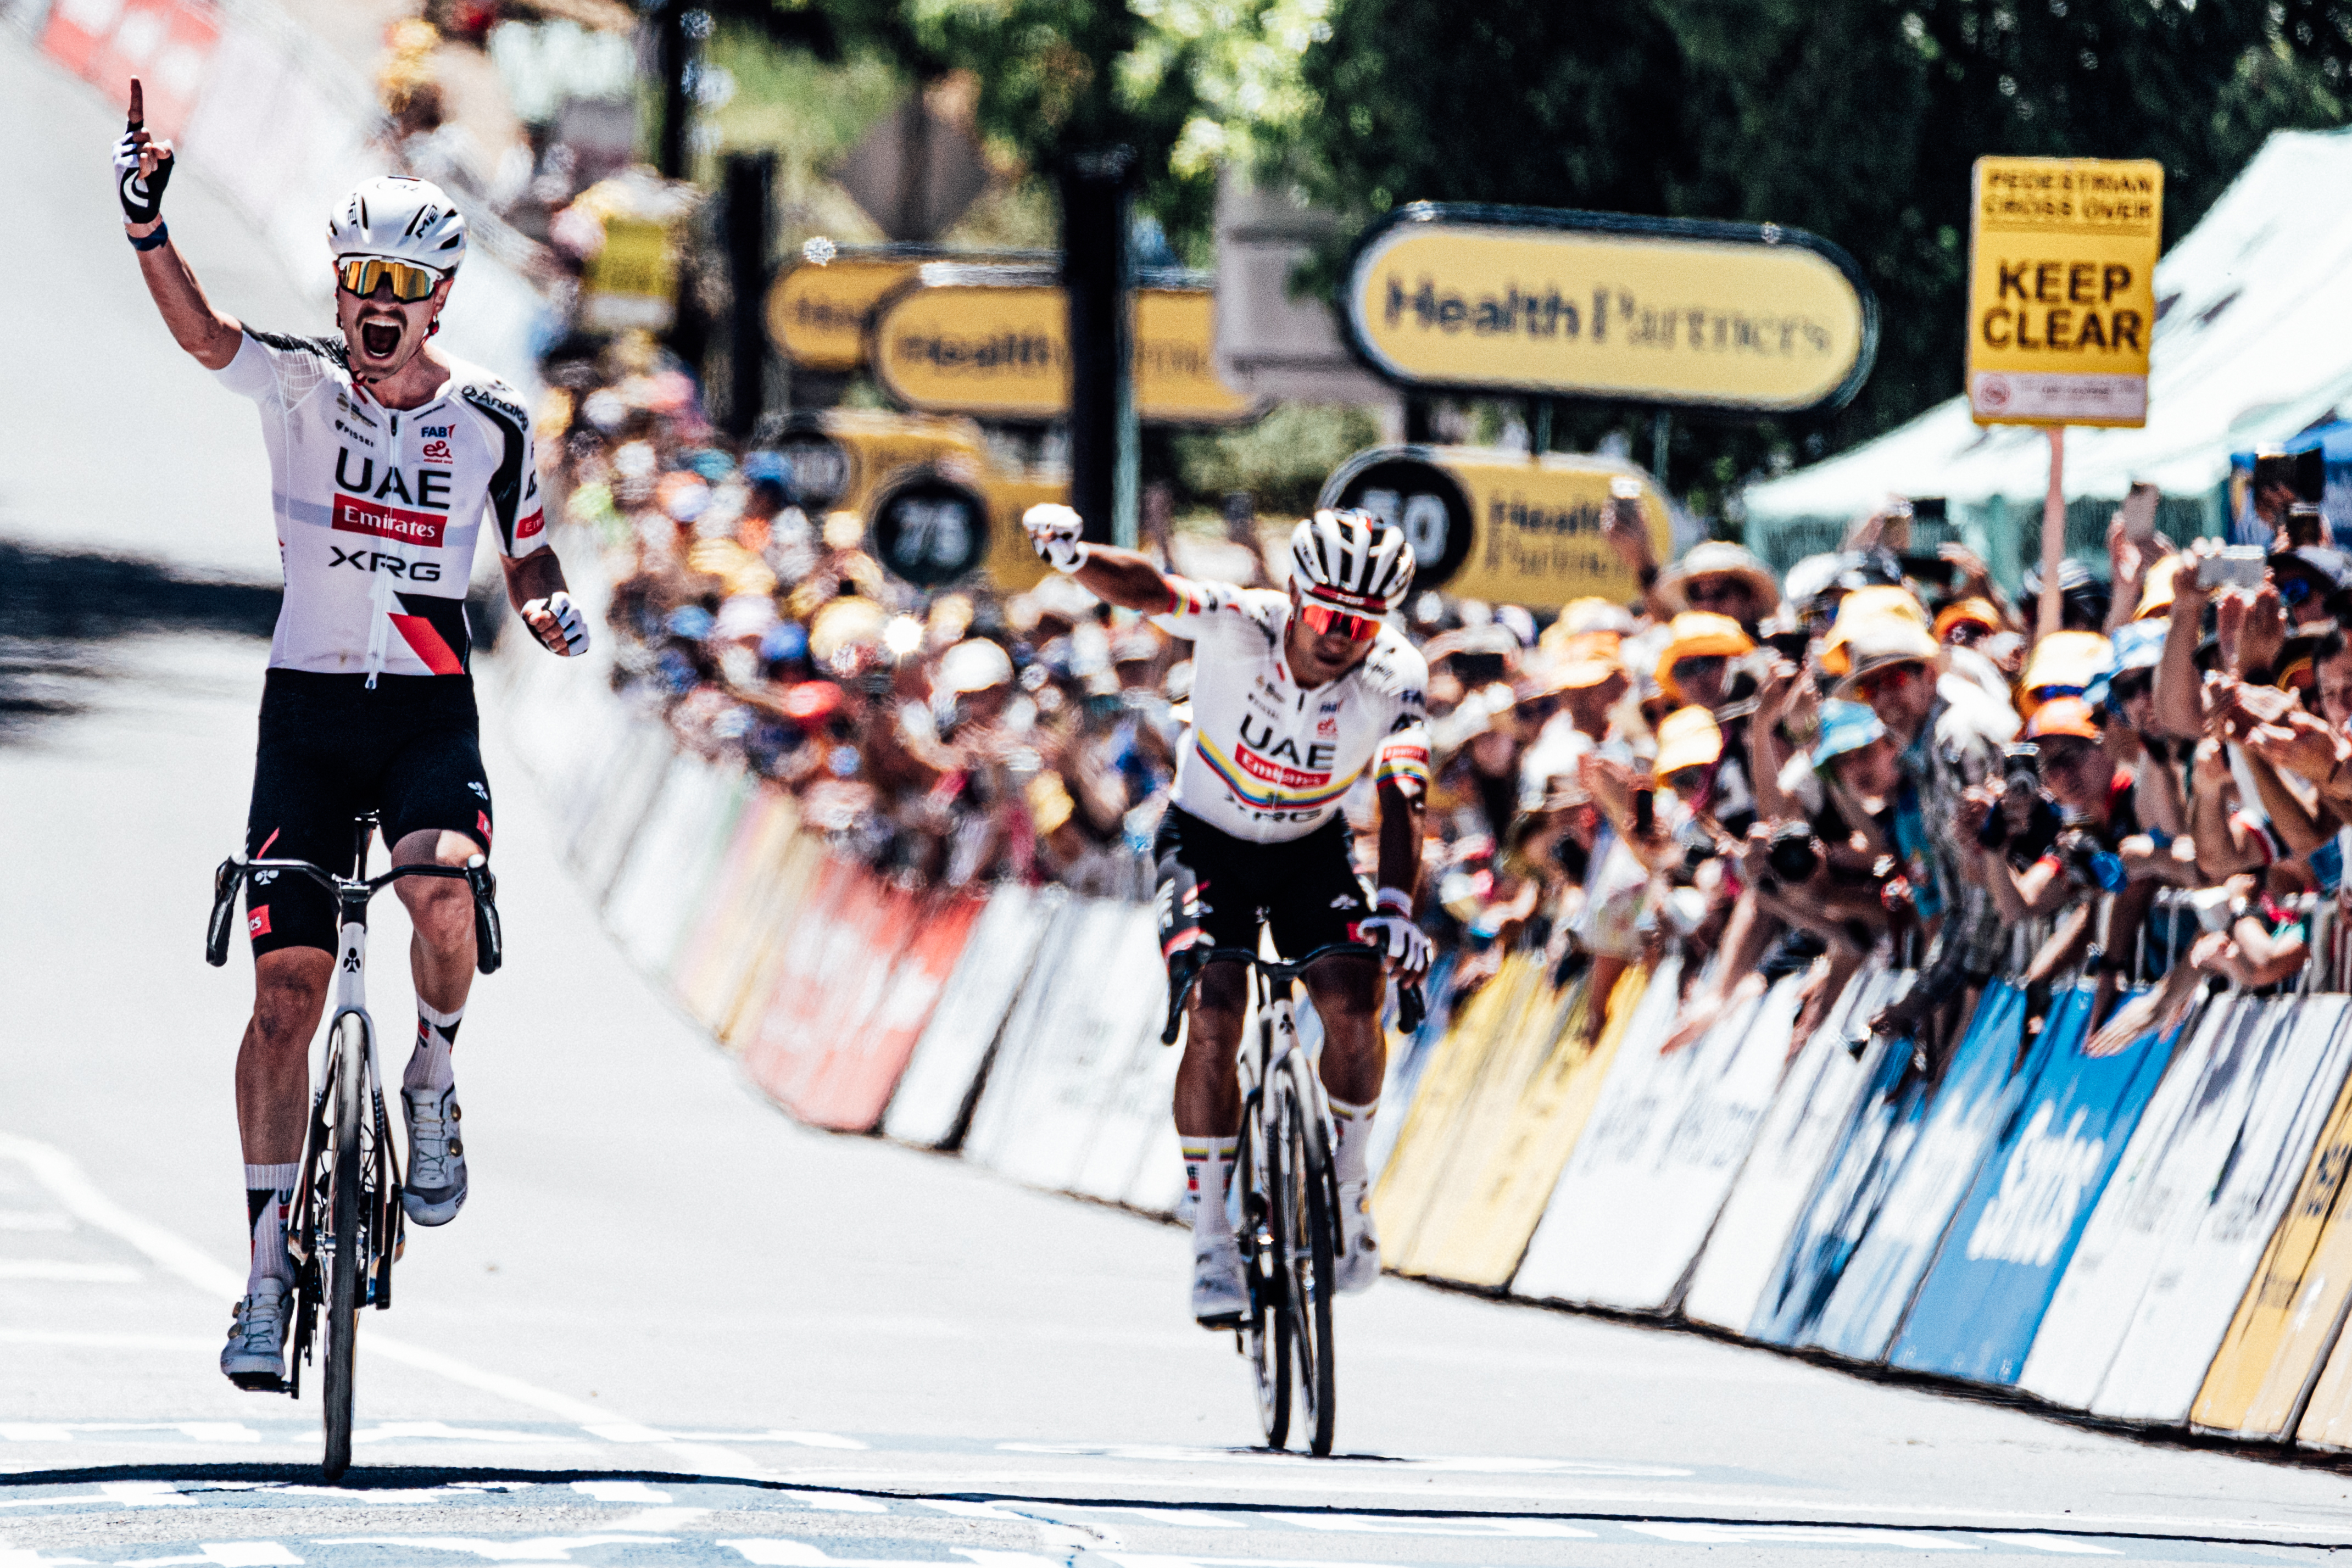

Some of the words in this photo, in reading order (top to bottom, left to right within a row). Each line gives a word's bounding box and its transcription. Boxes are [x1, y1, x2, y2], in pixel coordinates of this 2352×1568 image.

[1997, 259, 2132, 305] KEEP
[1384, 274, 1580, 338] Health
[1591, 286, 1833, 357] Partners
[1982, 307, 2142, 352] CLEAR
[421, 426, 448, 438] FAB
[477, 390, 528, 432] Analog
[335, 446, 451, 510] UAE
[344, 506, 436, 538] Emirates
[328, 546, 441, 582] XRG
[1240, 713, 1336, 770] UAE
